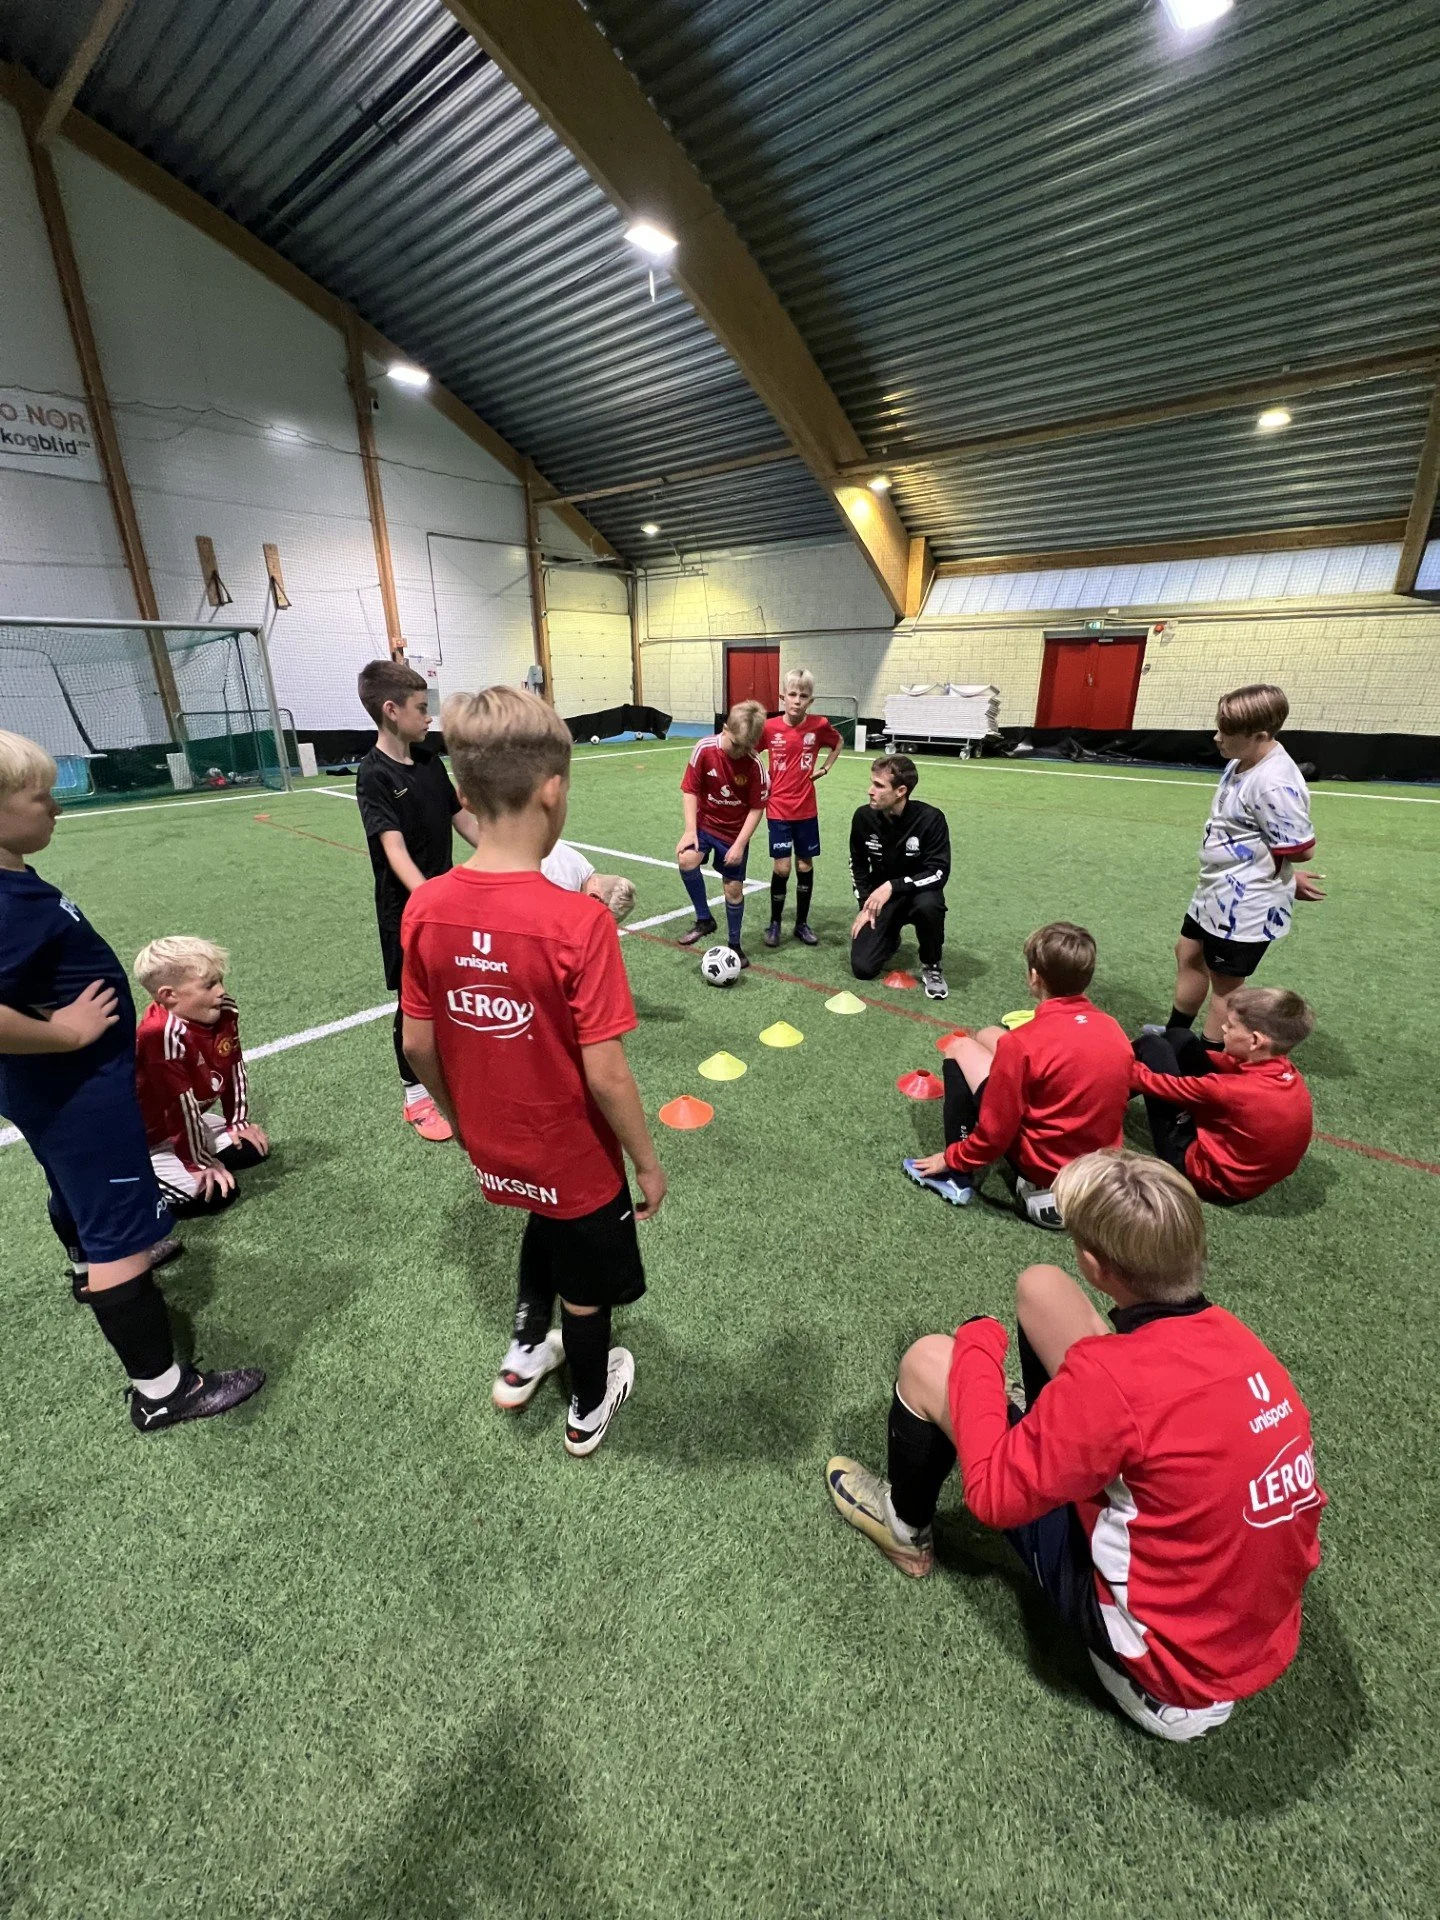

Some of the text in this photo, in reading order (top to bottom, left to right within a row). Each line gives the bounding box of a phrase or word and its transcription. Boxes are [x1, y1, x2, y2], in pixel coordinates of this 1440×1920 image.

[26, 404, 87, 434] NOR
[454, 954, 508, 974] unisport
[447, 990, 528, 1024] LERØY
[1249, 1398, 1293, 1434] unisport
